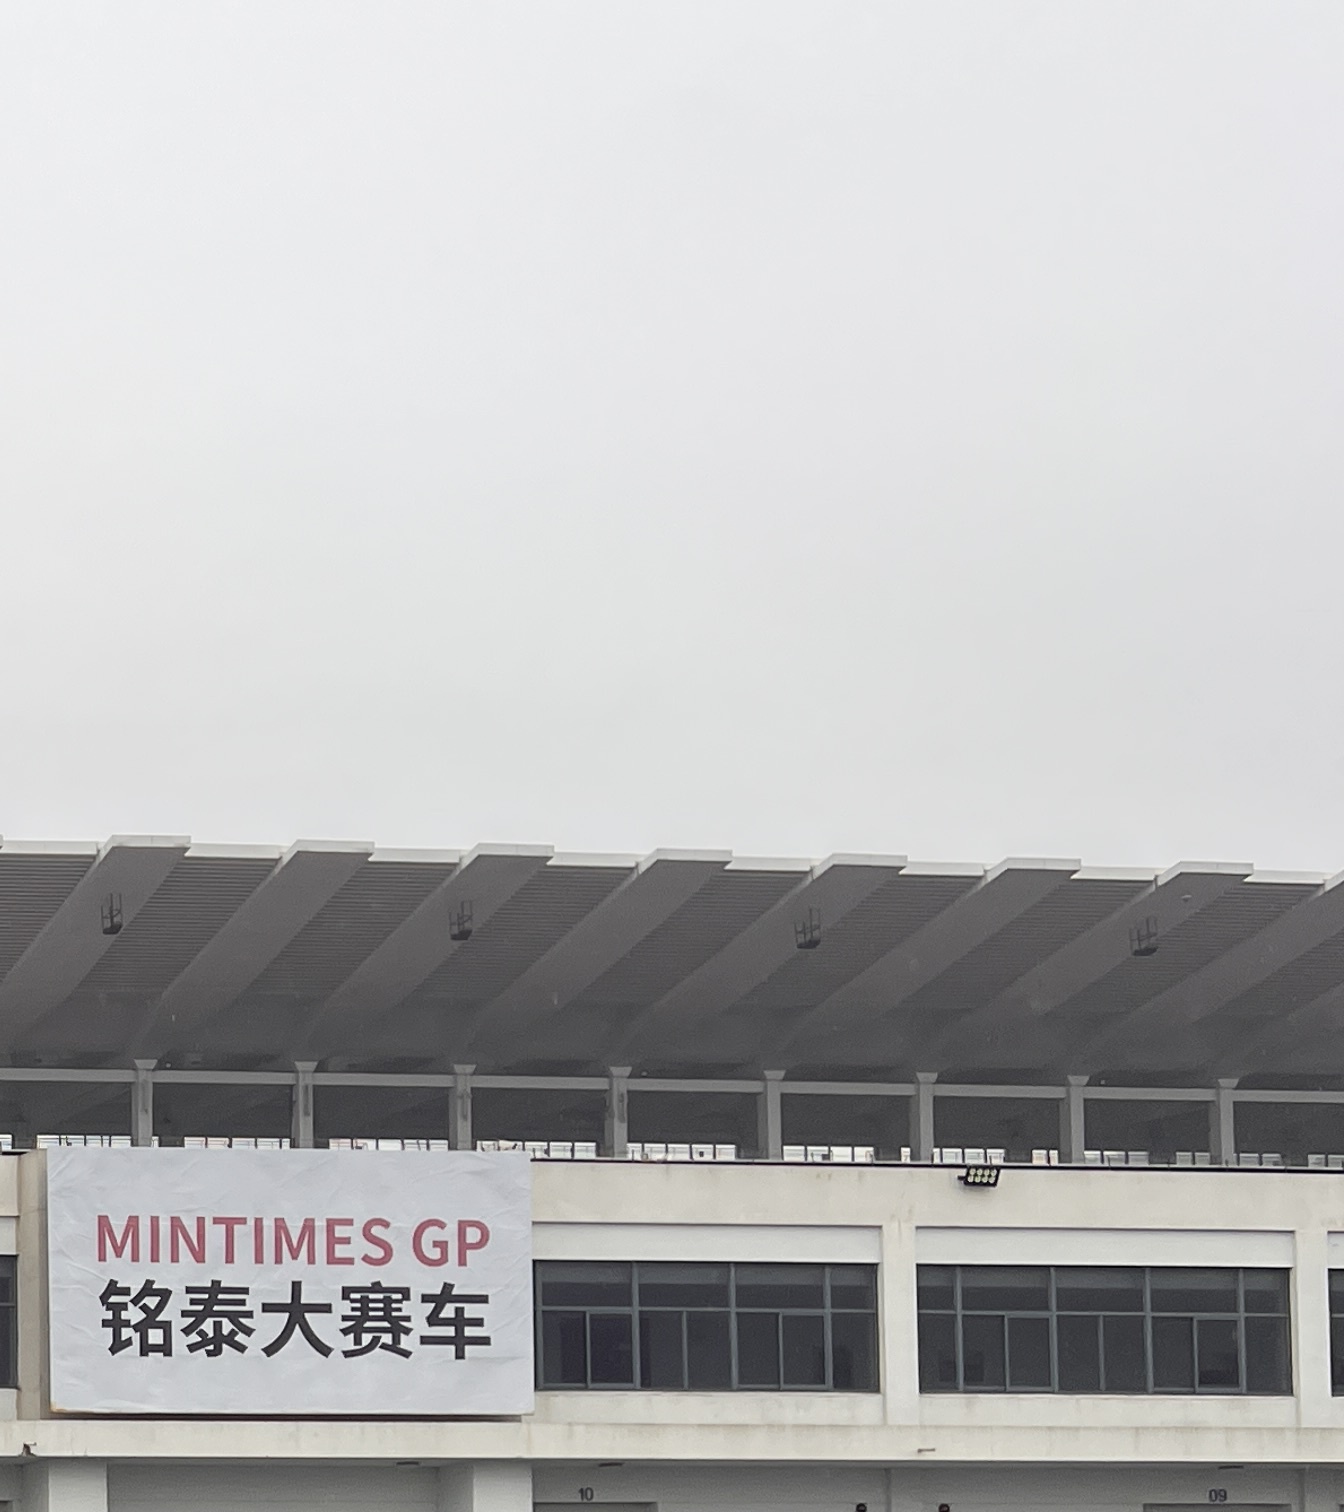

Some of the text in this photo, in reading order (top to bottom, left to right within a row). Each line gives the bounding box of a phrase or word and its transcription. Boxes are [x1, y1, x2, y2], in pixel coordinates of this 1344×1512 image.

[97, 1214, 491, 1267] MINTIMES GP
[98, 1278, 492, 1361] 铭泰大赛车
[577, 1486, 594, 1501] 10
[1208, 1488, 1228, 1502] 09
